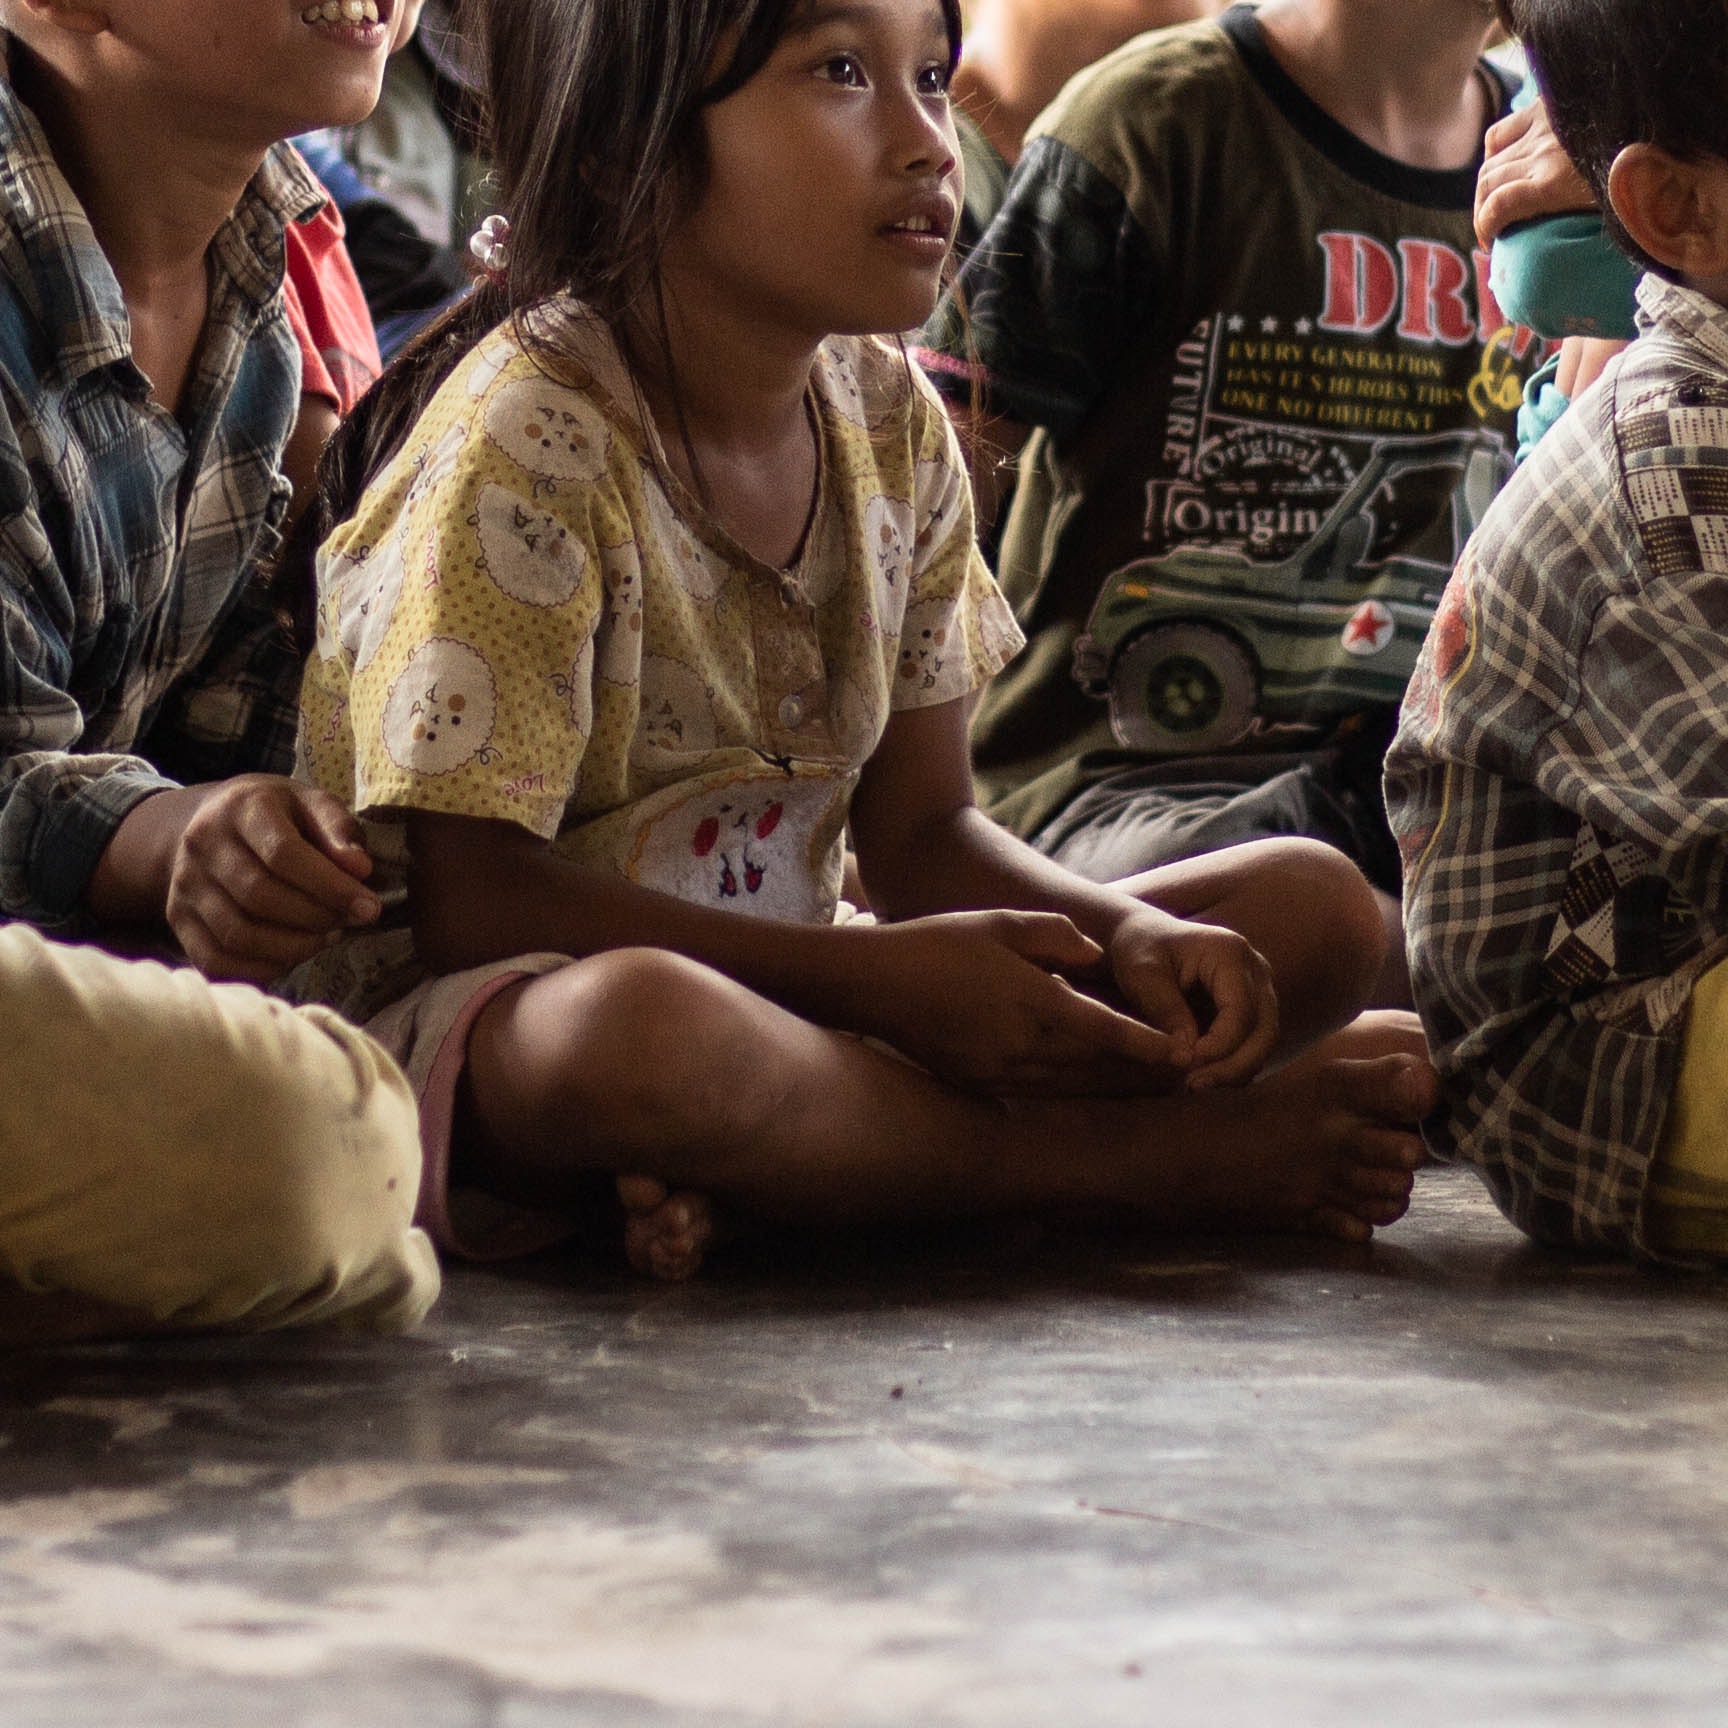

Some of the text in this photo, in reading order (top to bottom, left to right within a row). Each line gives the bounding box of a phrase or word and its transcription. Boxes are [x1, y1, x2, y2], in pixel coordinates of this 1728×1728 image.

[1228, 341, 1443, 378] EVERY GENERATION
[1327, 376, 1410, 402] HEROES
[1222, 388, 1438, 431] ONE NO DIFFERENT
